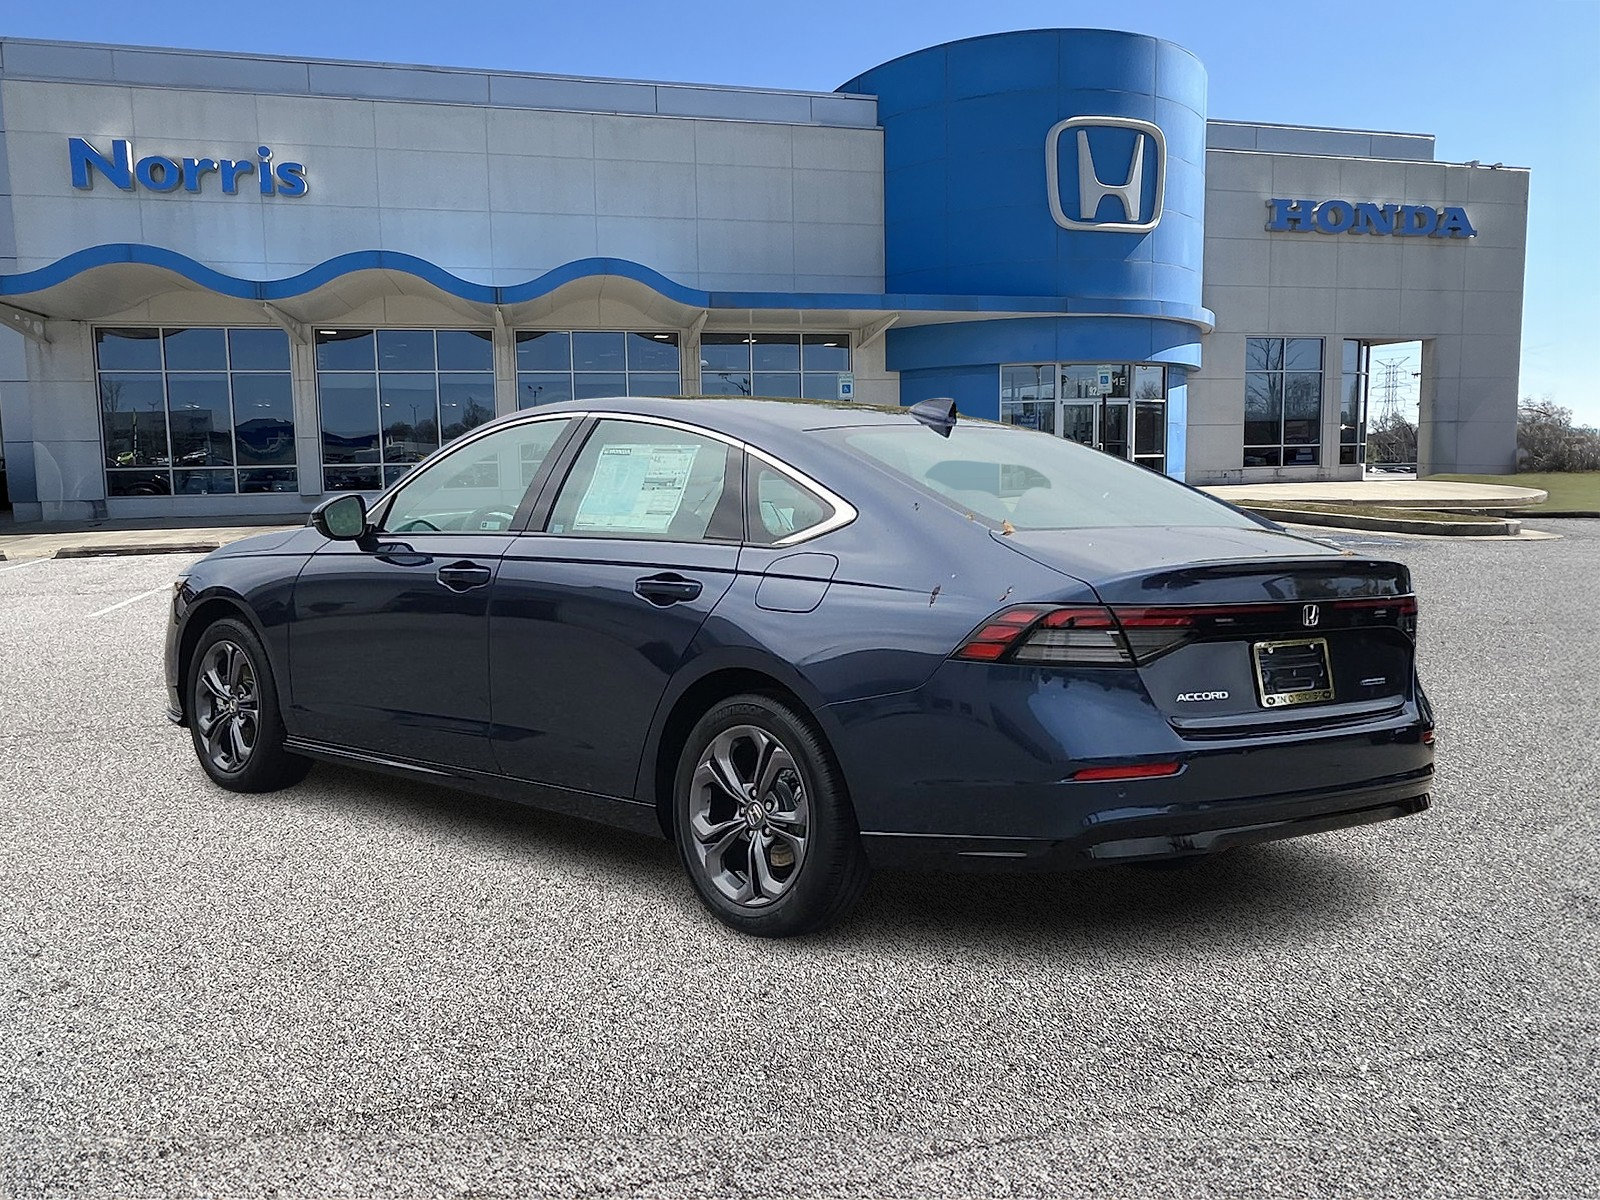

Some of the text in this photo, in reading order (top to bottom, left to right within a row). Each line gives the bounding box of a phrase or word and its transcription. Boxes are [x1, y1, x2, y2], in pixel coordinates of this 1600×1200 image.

[68, 137, 308, 197] Norris
[1265, 198, 1477, 239] HONDA
[1176, 691, 1229, 702] ACCORD
